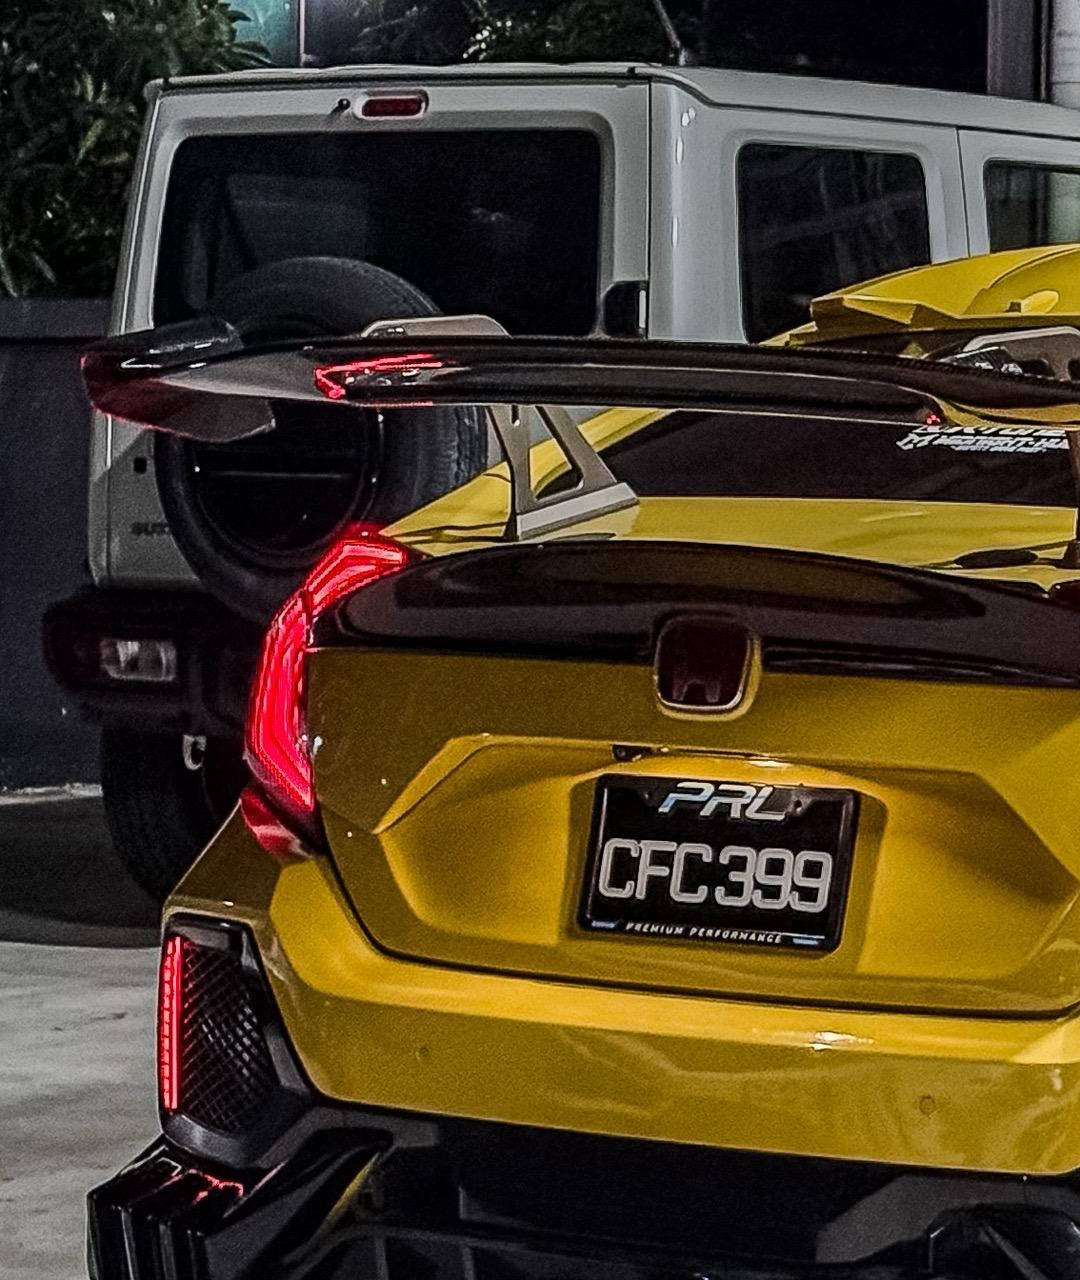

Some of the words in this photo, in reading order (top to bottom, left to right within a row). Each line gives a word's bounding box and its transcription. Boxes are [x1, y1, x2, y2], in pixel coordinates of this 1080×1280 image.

[657, 781, 788, 821] PRL
[625, 922, 684, 935] PREMIUM
[689, 927, 782, 944] PERFORMANCE
